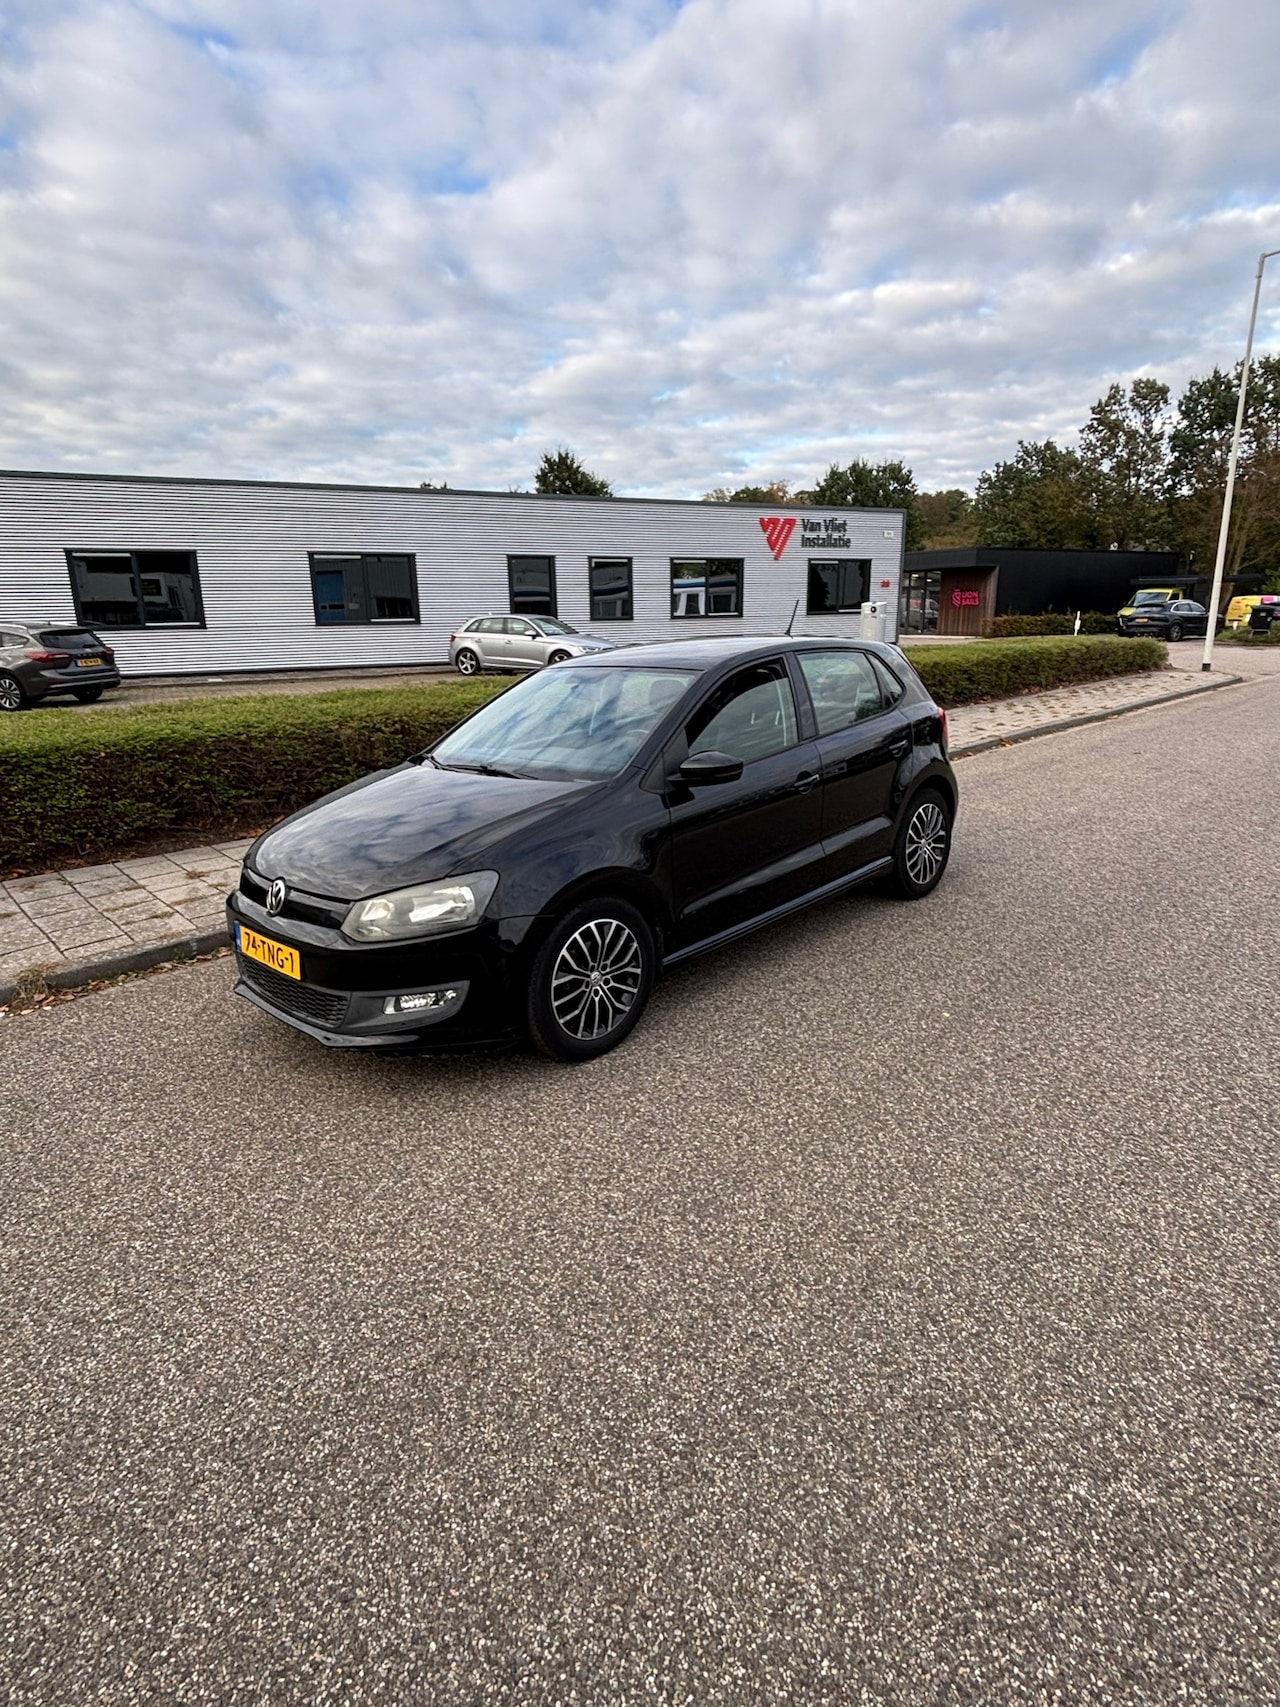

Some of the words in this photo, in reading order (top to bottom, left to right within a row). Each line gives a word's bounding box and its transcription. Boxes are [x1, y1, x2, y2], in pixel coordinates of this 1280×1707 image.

[801, 518, 821, 532] Van
[823, 517, 847, 532] Vliet
[801, 533, 851, 548] Installatie
[244, 931, 295, 973] 74-TNG-1
